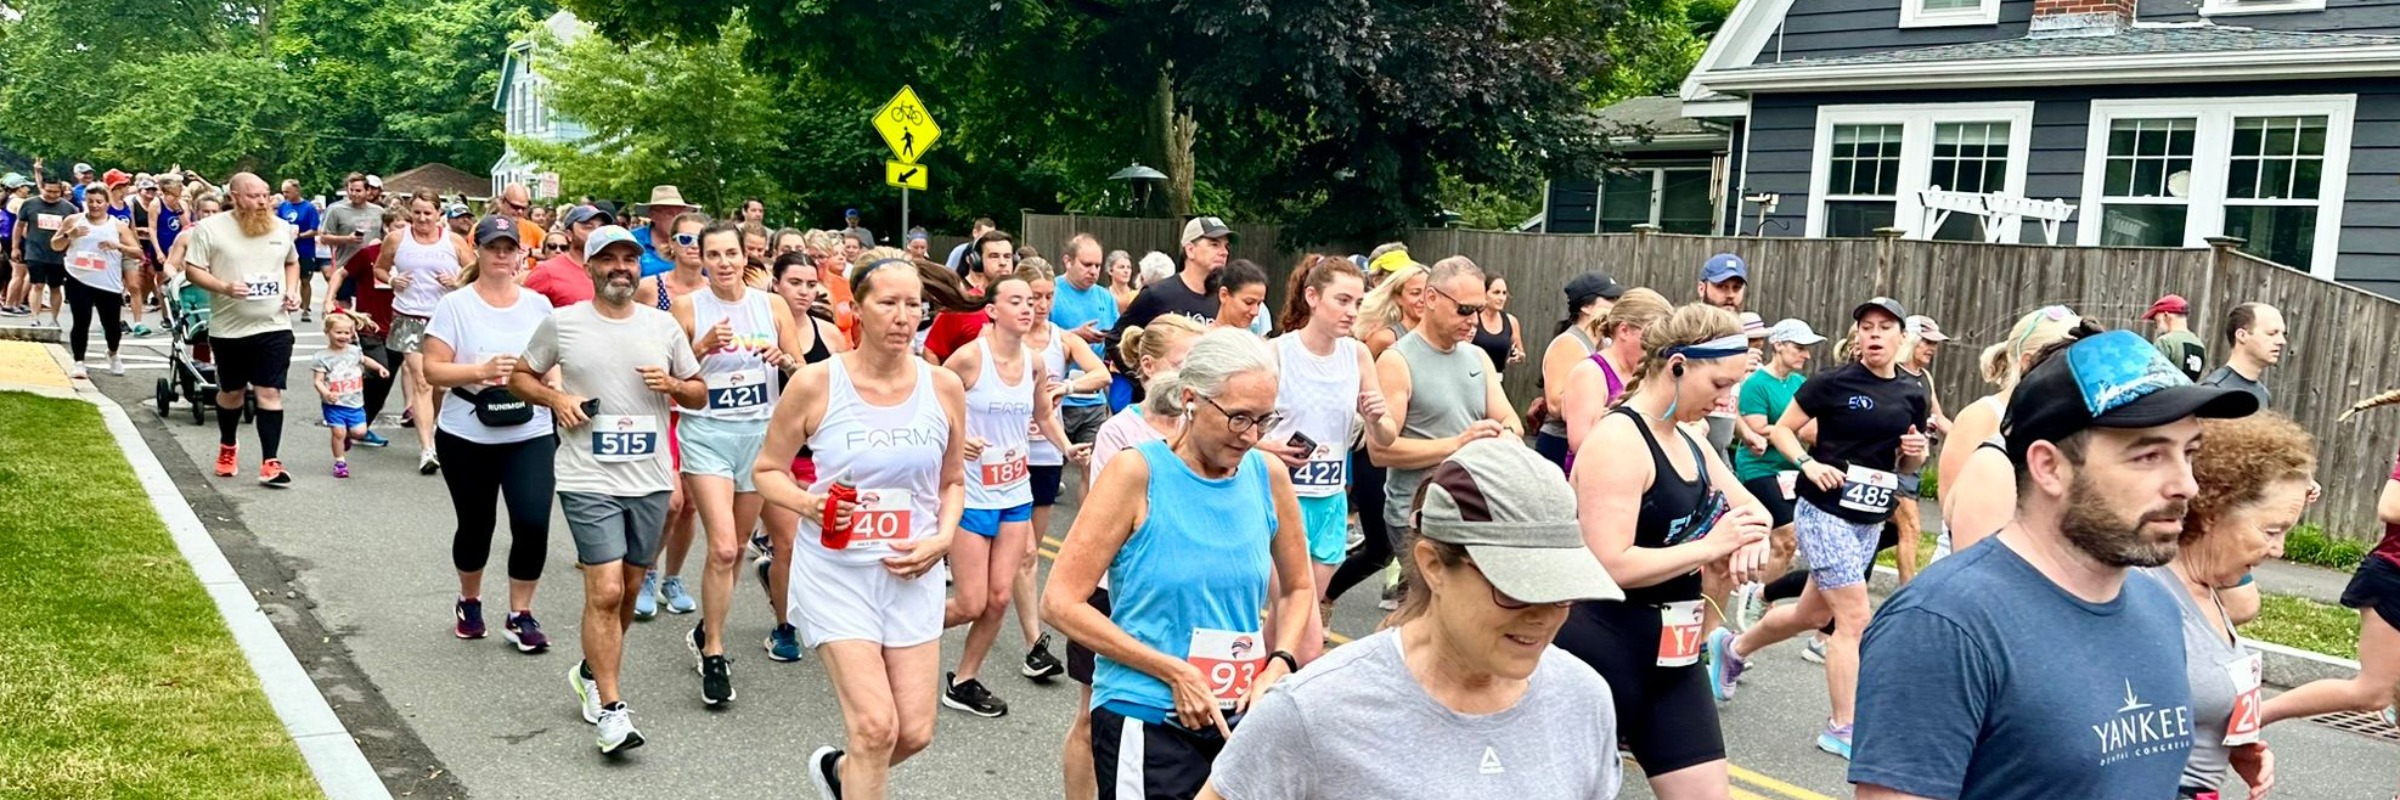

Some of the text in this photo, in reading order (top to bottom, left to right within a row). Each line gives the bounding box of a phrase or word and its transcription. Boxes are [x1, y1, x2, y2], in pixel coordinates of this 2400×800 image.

[251, 283, 278, 295] 462
[718, 385, 761, 407] 421
[602, 433, 647, 454] 515
[846, 428, 933, 450] FORM
[990, 461, 1024, 484] 189
[1294, 462, 1341, 485] 422
[1846, 484, 1892, 506] 485
[853, 512, 899, 538] 40
[1211, 662, 1256, 696] 93
[2092, 706, 2190, 754] YANKEE
